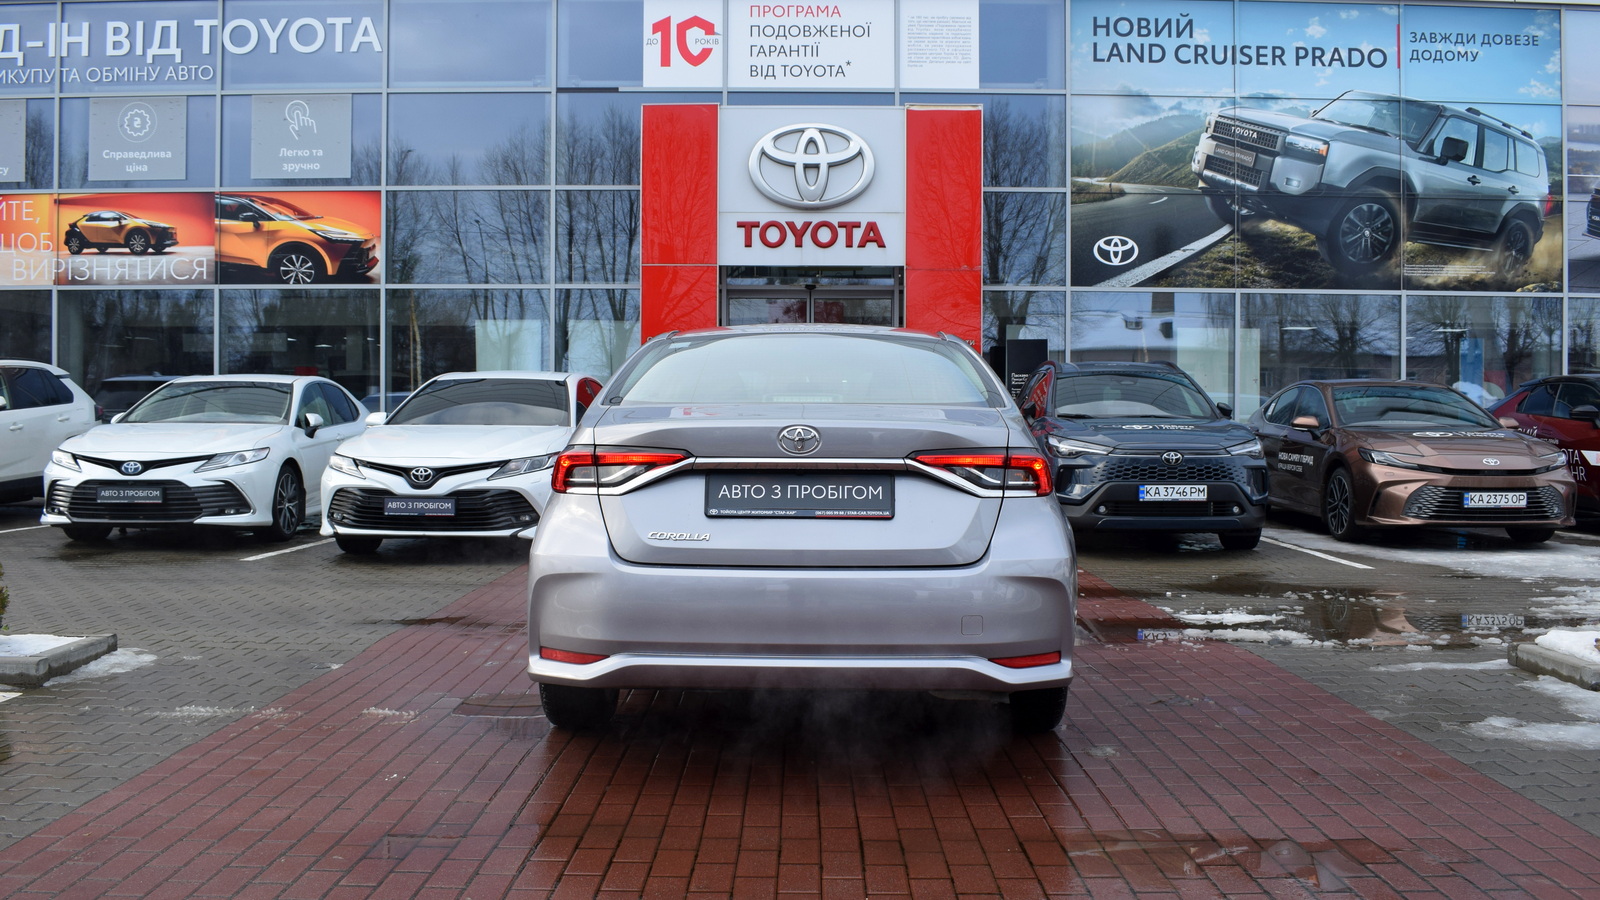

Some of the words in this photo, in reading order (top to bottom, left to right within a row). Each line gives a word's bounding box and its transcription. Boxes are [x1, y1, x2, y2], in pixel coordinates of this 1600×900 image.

[750, 5, 842, 18] ПРОГРАМА
[750, 22, 872, 40] ПОДОВЖЕНОЇ
[1093, 13, 1194, 38] НОВИЙ
[106, 20, 182, 64] ВІД
[194, 17, 383, 55] TOYOTA
[646, 38, 659, 46] ДО
[694, 38, 720, 46] РОКІВ
[1410, 32, 1476, 46] ЗАВЖДИ
[1481, 34, 1539, 47] ДОВЕЗЕ
[750, 42, 821, 57] ГАРАНТІЇ
[1093, 42, 1167, 63] LAND
[1174, 44, 1287, 66] CRUISER
[1295, 46, 1388, 69] PRADO
[1410, 50, 1479, 63] ДОДОМУ
[60, 68, 81, 83] ТА
[86, 66, 161, 82] ОБМІНУ
[165, 65, 214, 81] АВТО
[750, 65, 777, 80] ВІД
[103, 149, 172, 160] Справедлива
[280, 148, 310, 157] Легко
[312, 149, 324, 157] та
[126, 162, 149, 173] ціна
[282, 163, 321, 172] зручно
[736, 220, 887, 248] TOYOTA
[13, 257, 207, 281] ВИРІЗНЯТИСЯ
[718, 484, 766, 499] АВТО
[771, 485, 781, 499] З
[787, 485, 883, 500] ПРОБІГОМ
[1146, 487, 1160, 497] KA
[1163, 487, 1188, 497] 3746
[1190, 487, 1206, 497] PM
[1469, 494, 1485, 504] KA
[1486, 494, 1509, 504] 2375
[1511, 494, 1526, 504] OP
[413, 502, 452, 510] ПРОБІГОМ
[648, 531, 711, 541] COROLLA
